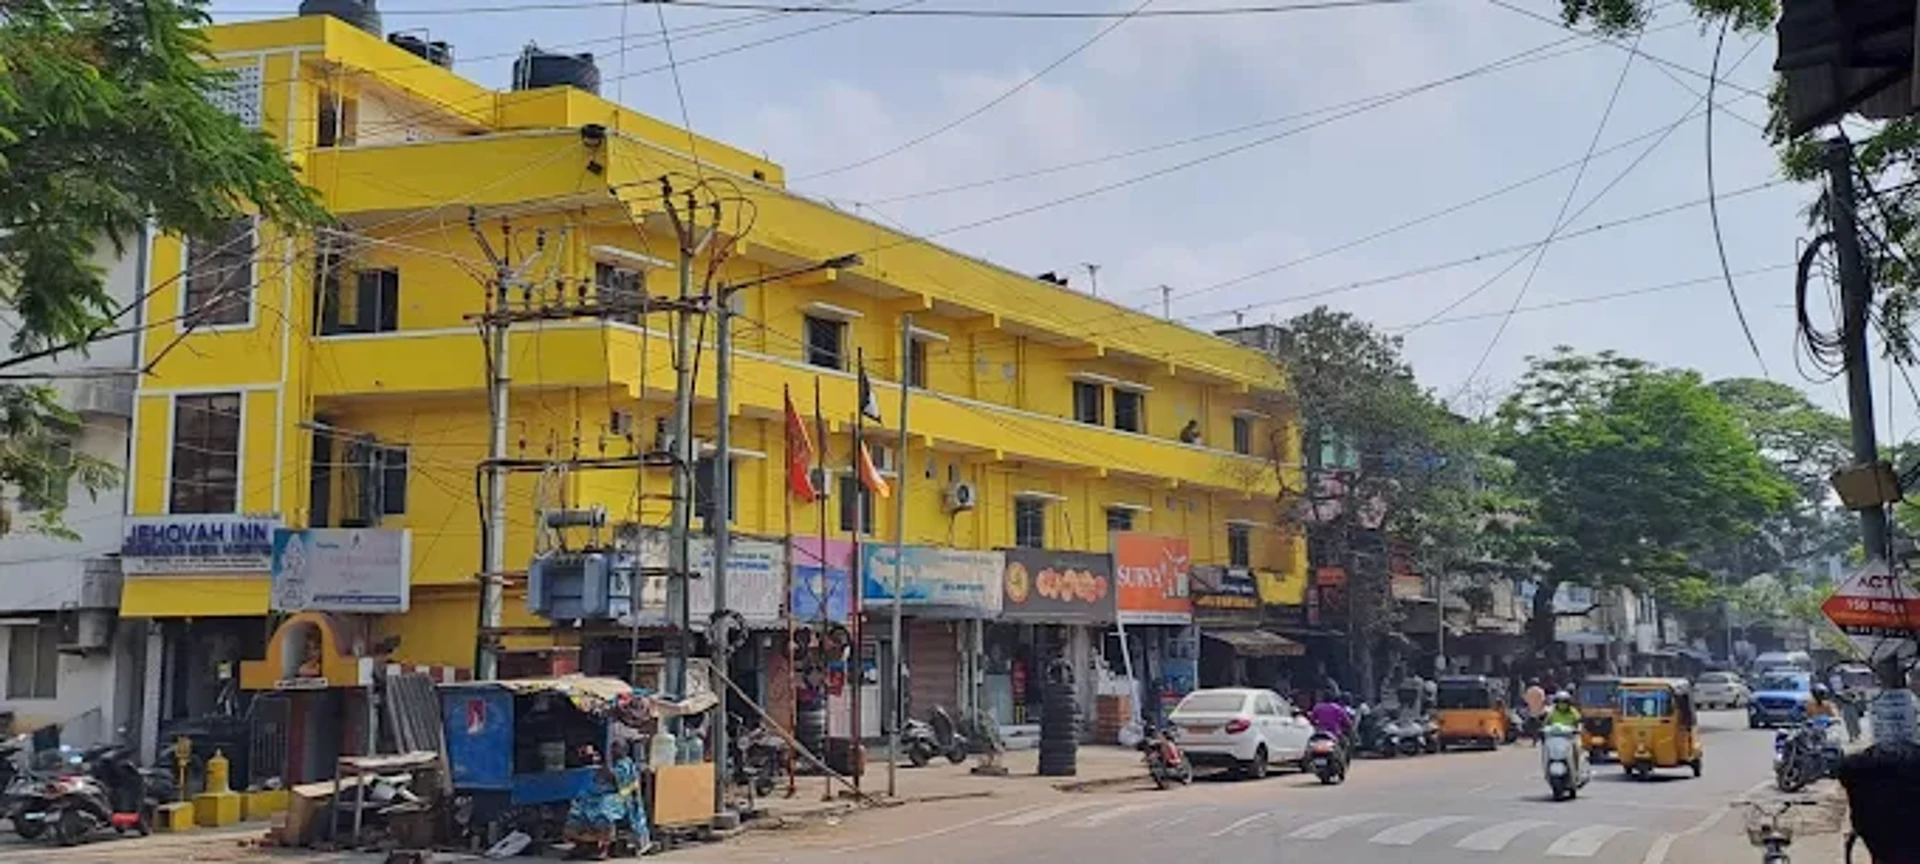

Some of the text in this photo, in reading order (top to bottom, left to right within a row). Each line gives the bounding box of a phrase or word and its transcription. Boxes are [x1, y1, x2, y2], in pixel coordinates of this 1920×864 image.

[126, 522, 267, 543] JEHOVAH INN
[1858, 575, 1895, 588] ACT
